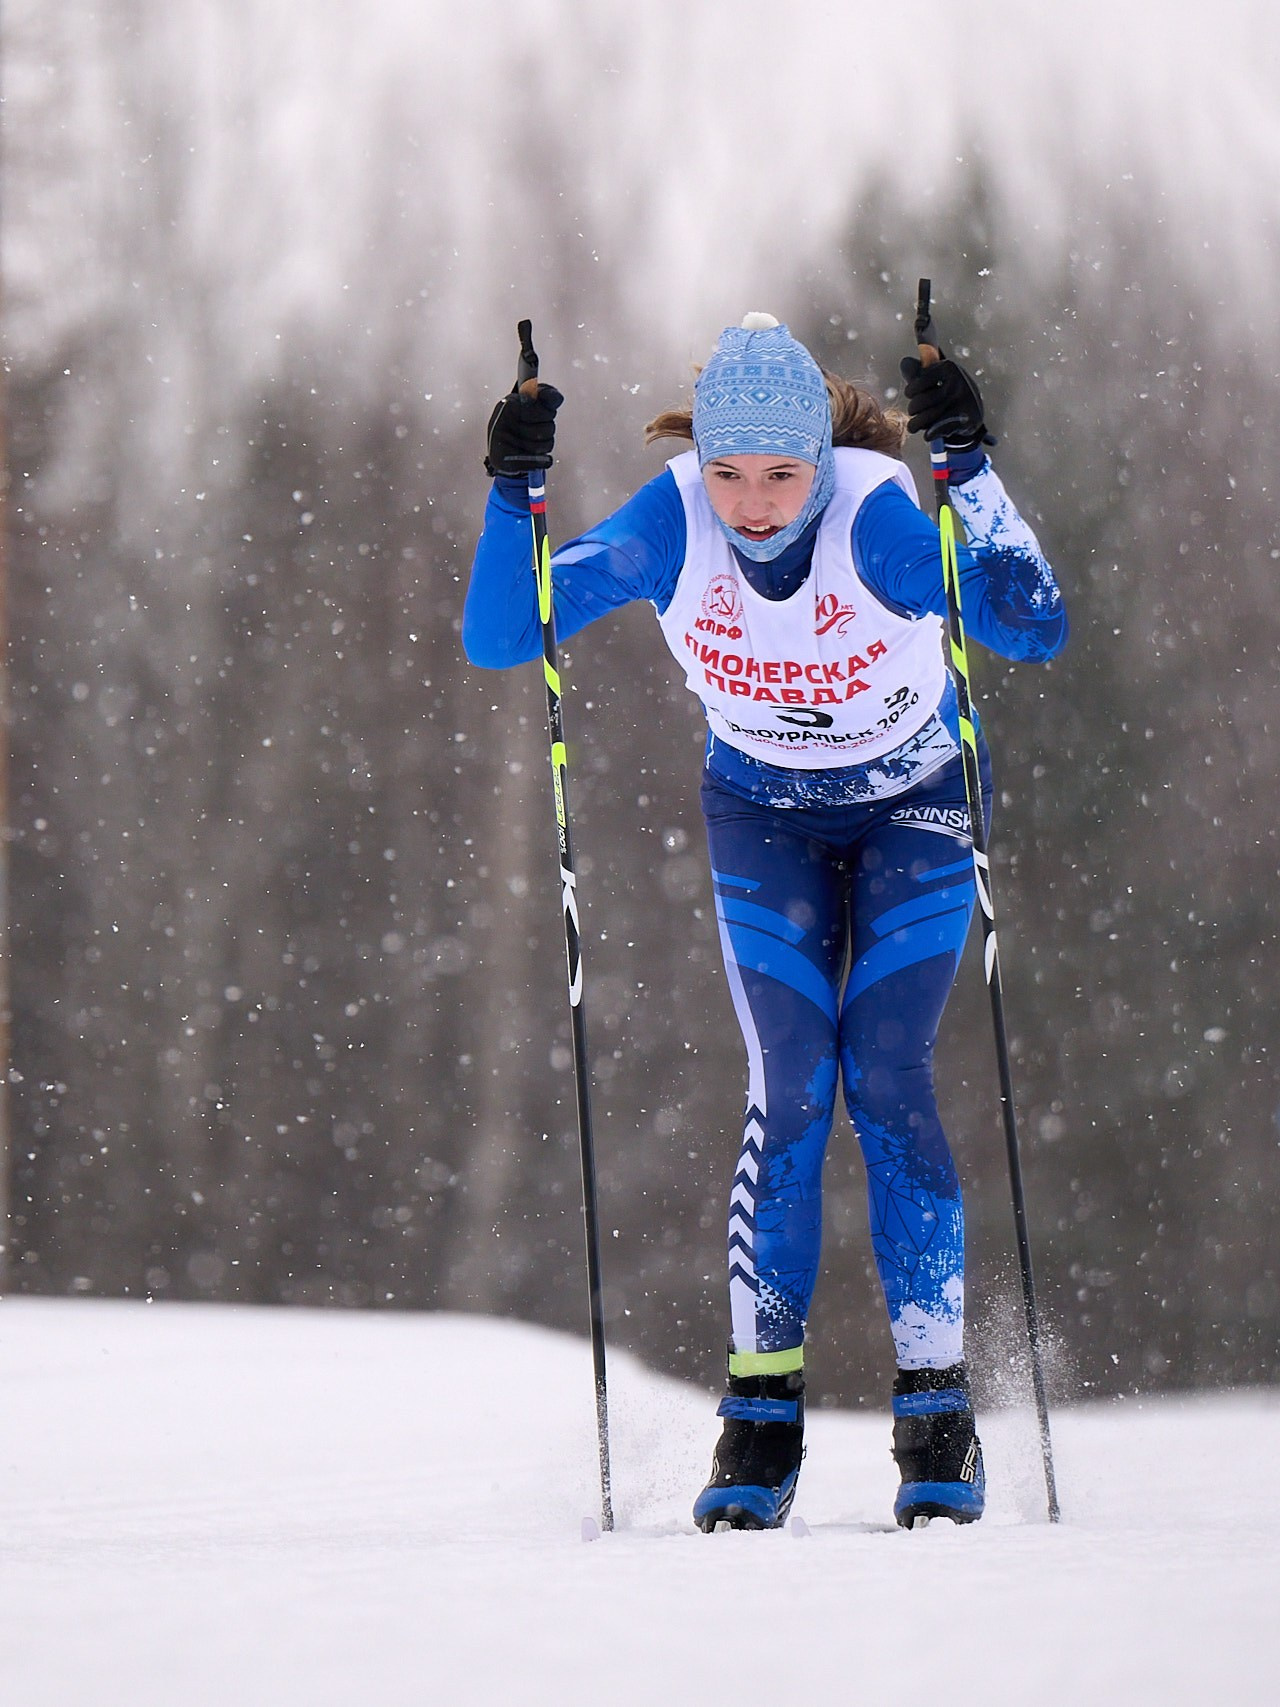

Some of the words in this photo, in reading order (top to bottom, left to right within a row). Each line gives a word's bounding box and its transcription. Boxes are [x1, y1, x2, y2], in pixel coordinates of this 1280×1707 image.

[695, 617, 743, 640] КПРФ
[684, 632, 888, 684] ПИОНЕРСКАЯ
[704, 668, 872, 706] ПРАВДА
[876, 692, 919, 729] 2020
